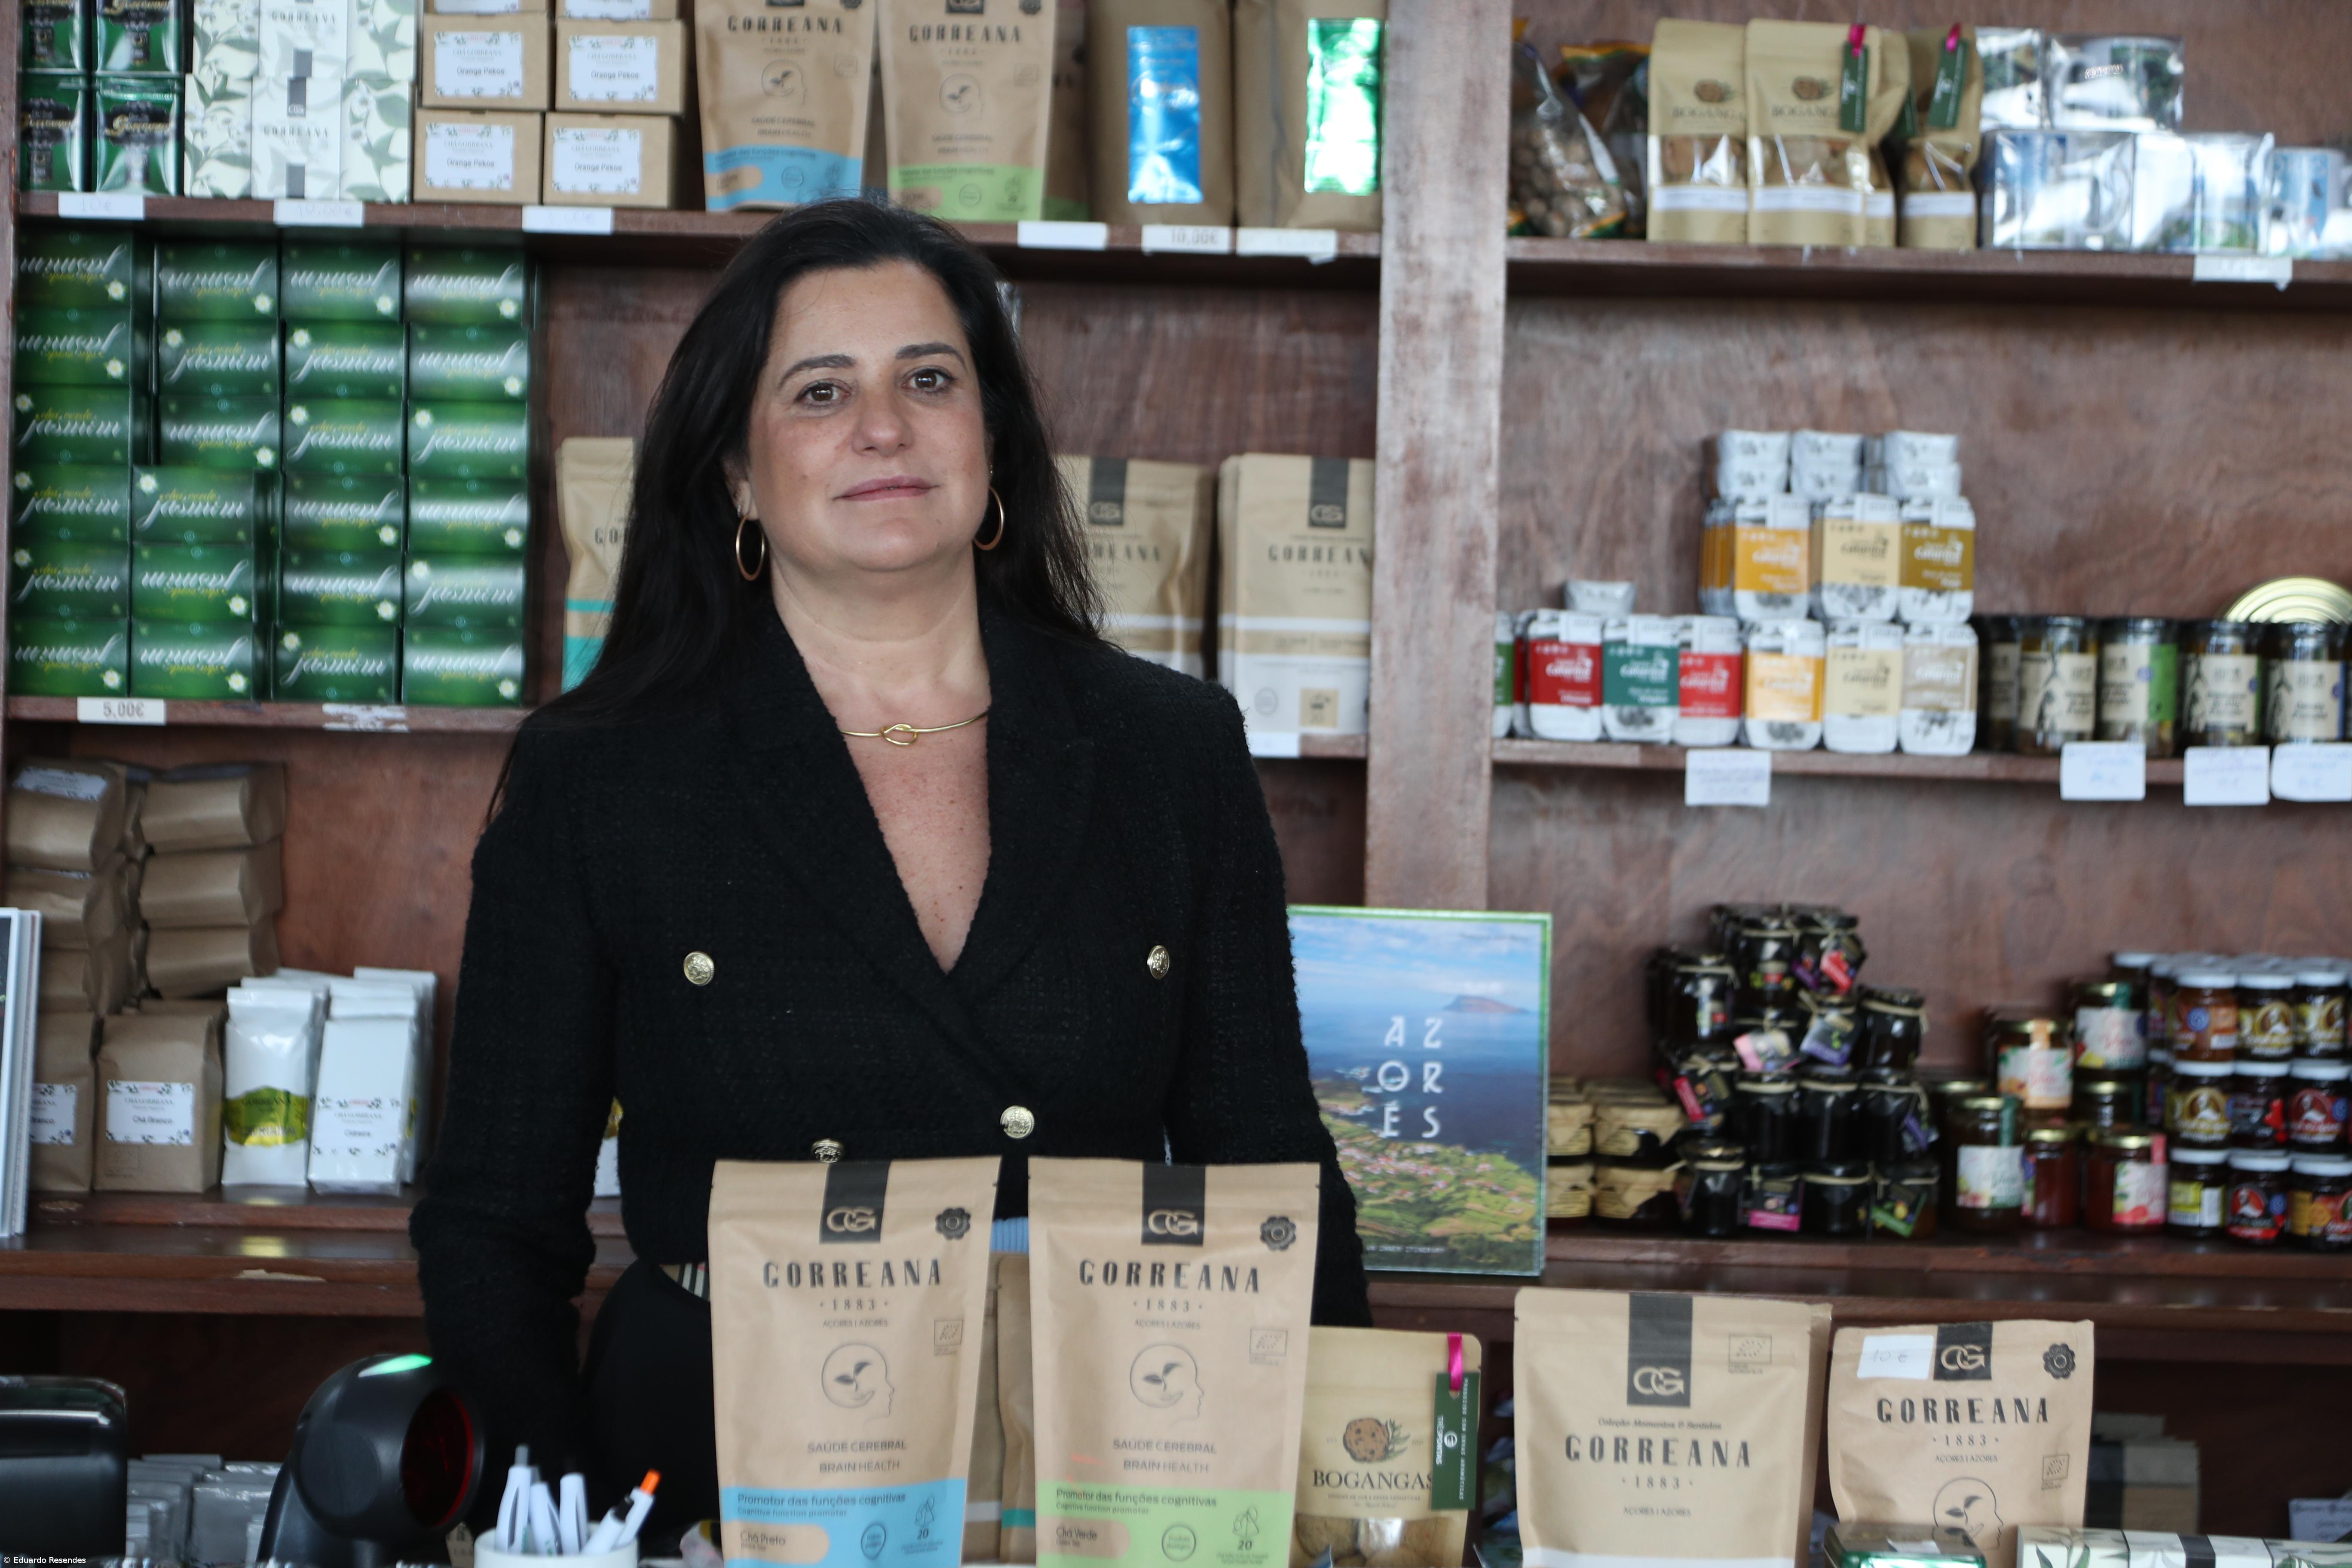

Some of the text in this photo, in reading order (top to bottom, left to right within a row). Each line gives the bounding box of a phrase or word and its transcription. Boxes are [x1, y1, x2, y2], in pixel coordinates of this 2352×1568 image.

[727, 15, 843, 34] GORREANA
[909, 24, 1021, 43] GORREANA
[457, 67, 482, 76] Orange
[591, 71, 639, 80] Orange Pekoe
[447, 158, 495, 167] Orange Pekoe
[575, 162, 622, 171] Orange Pekoe
[103, 702, 144, 718] 5,00€
[763, 1259, 941, 1288] GORREANA
[1079, 1260, 1259, 1294] GORREANA
[832, 1298, 876, 1311] 1883
[1146, 1299, 1190, 1312] 1883
[1872, 1349, 1891, 1363] 10
[1877, 1397, 2049, 1424] GORREANA
[1634, 1419, 1675, 1428] Momentos
[1687, 1420, 1722, 1430] Sentidos
[807, 1439, 906, 1453] SAÚDE CEREBRAL
[1113, 1438, 1217, 1455] SAÚDE CEREBRAL
[1944, 1434, 1987, 1446] 1883
[1565, 1435, 1750, 1468] GORREANA
[819, 1460, 900, 1473] BRAIN HEALTH
[1123, 1460, 1209, 1474] BRAIN HEALTH
[1635, 1476, 1680, 1489] 1883
[738, 1492, 906, 1508] Promotor das funções cognitivas
[1056, 1489, 1217, 1508] Promotor das funções cognitivas
[740, 1531, 785, 1546] Chá Preto
[1056, 1526, 1098, 1541] Chá Verde
[1237, 1540, 1253, 1551] 20
